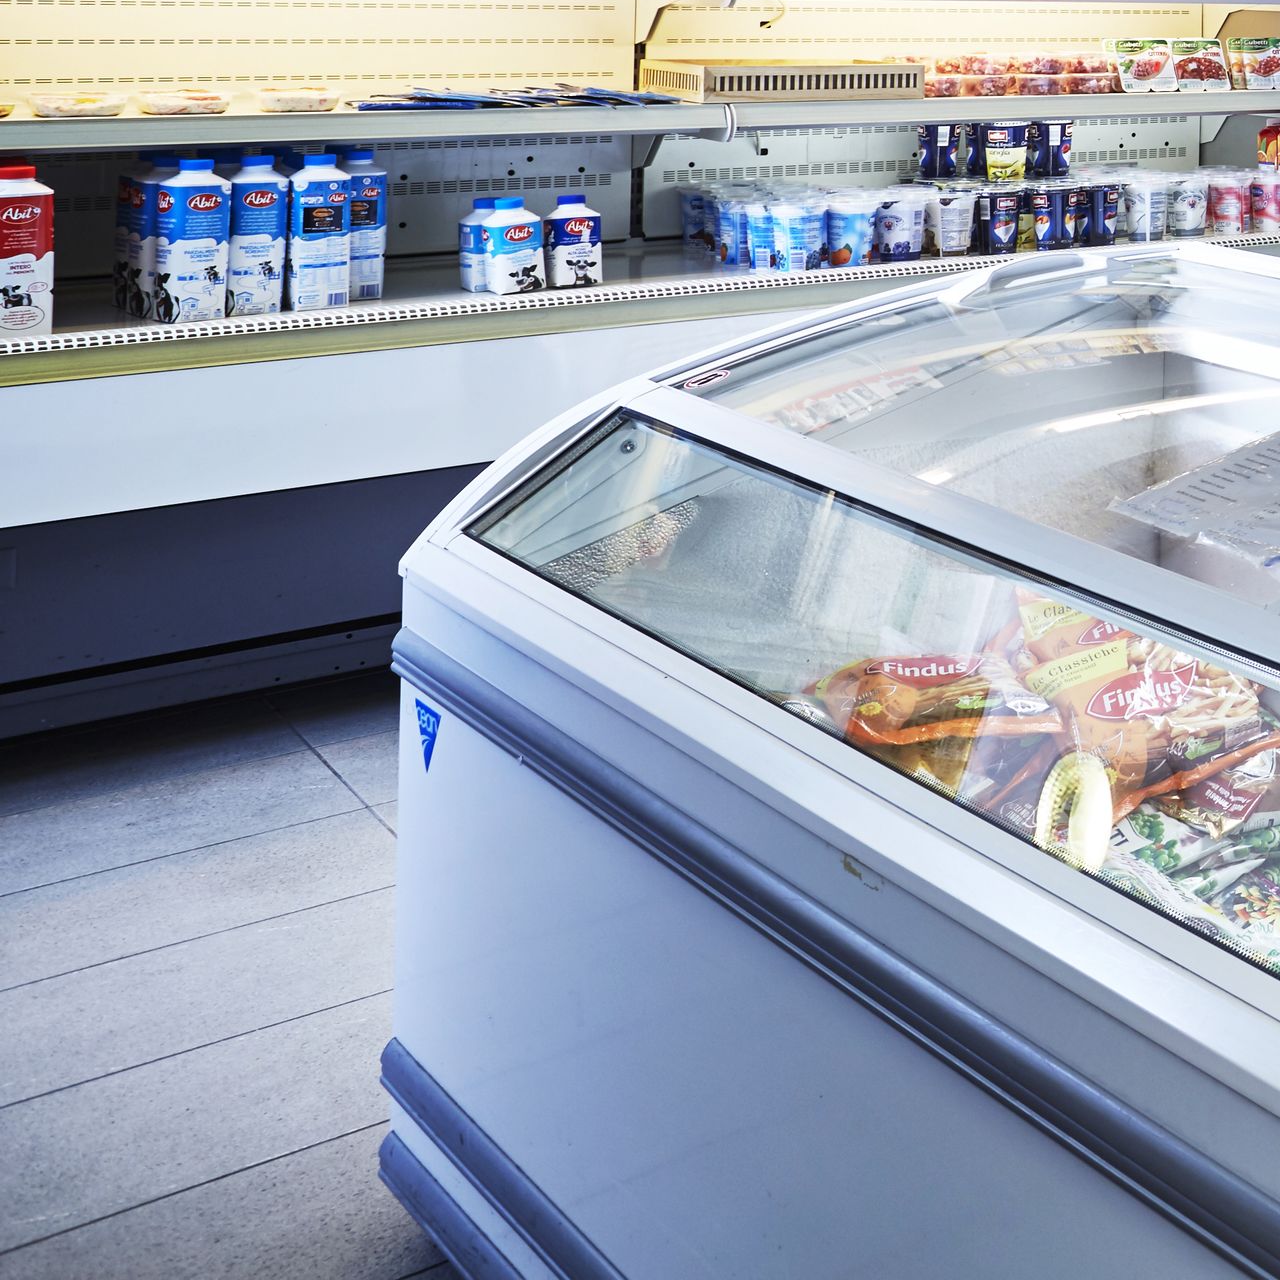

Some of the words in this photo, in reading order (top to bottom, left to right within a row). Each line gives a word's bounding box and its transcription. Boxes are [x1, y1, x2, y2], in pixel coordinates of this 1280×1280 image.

[190, 195, 218, 209] Abit
[246, 192, 274, 207] Abit
[1, 206, 38, 222] Abit
[567, 218, 591, 233] Abit
[505, 226, 531, 241] Abit
[883, 661, 968, 677] Findus
[1032, 675, 1046, 691] Le
[1049, 644, 1120, 679] Classiche
